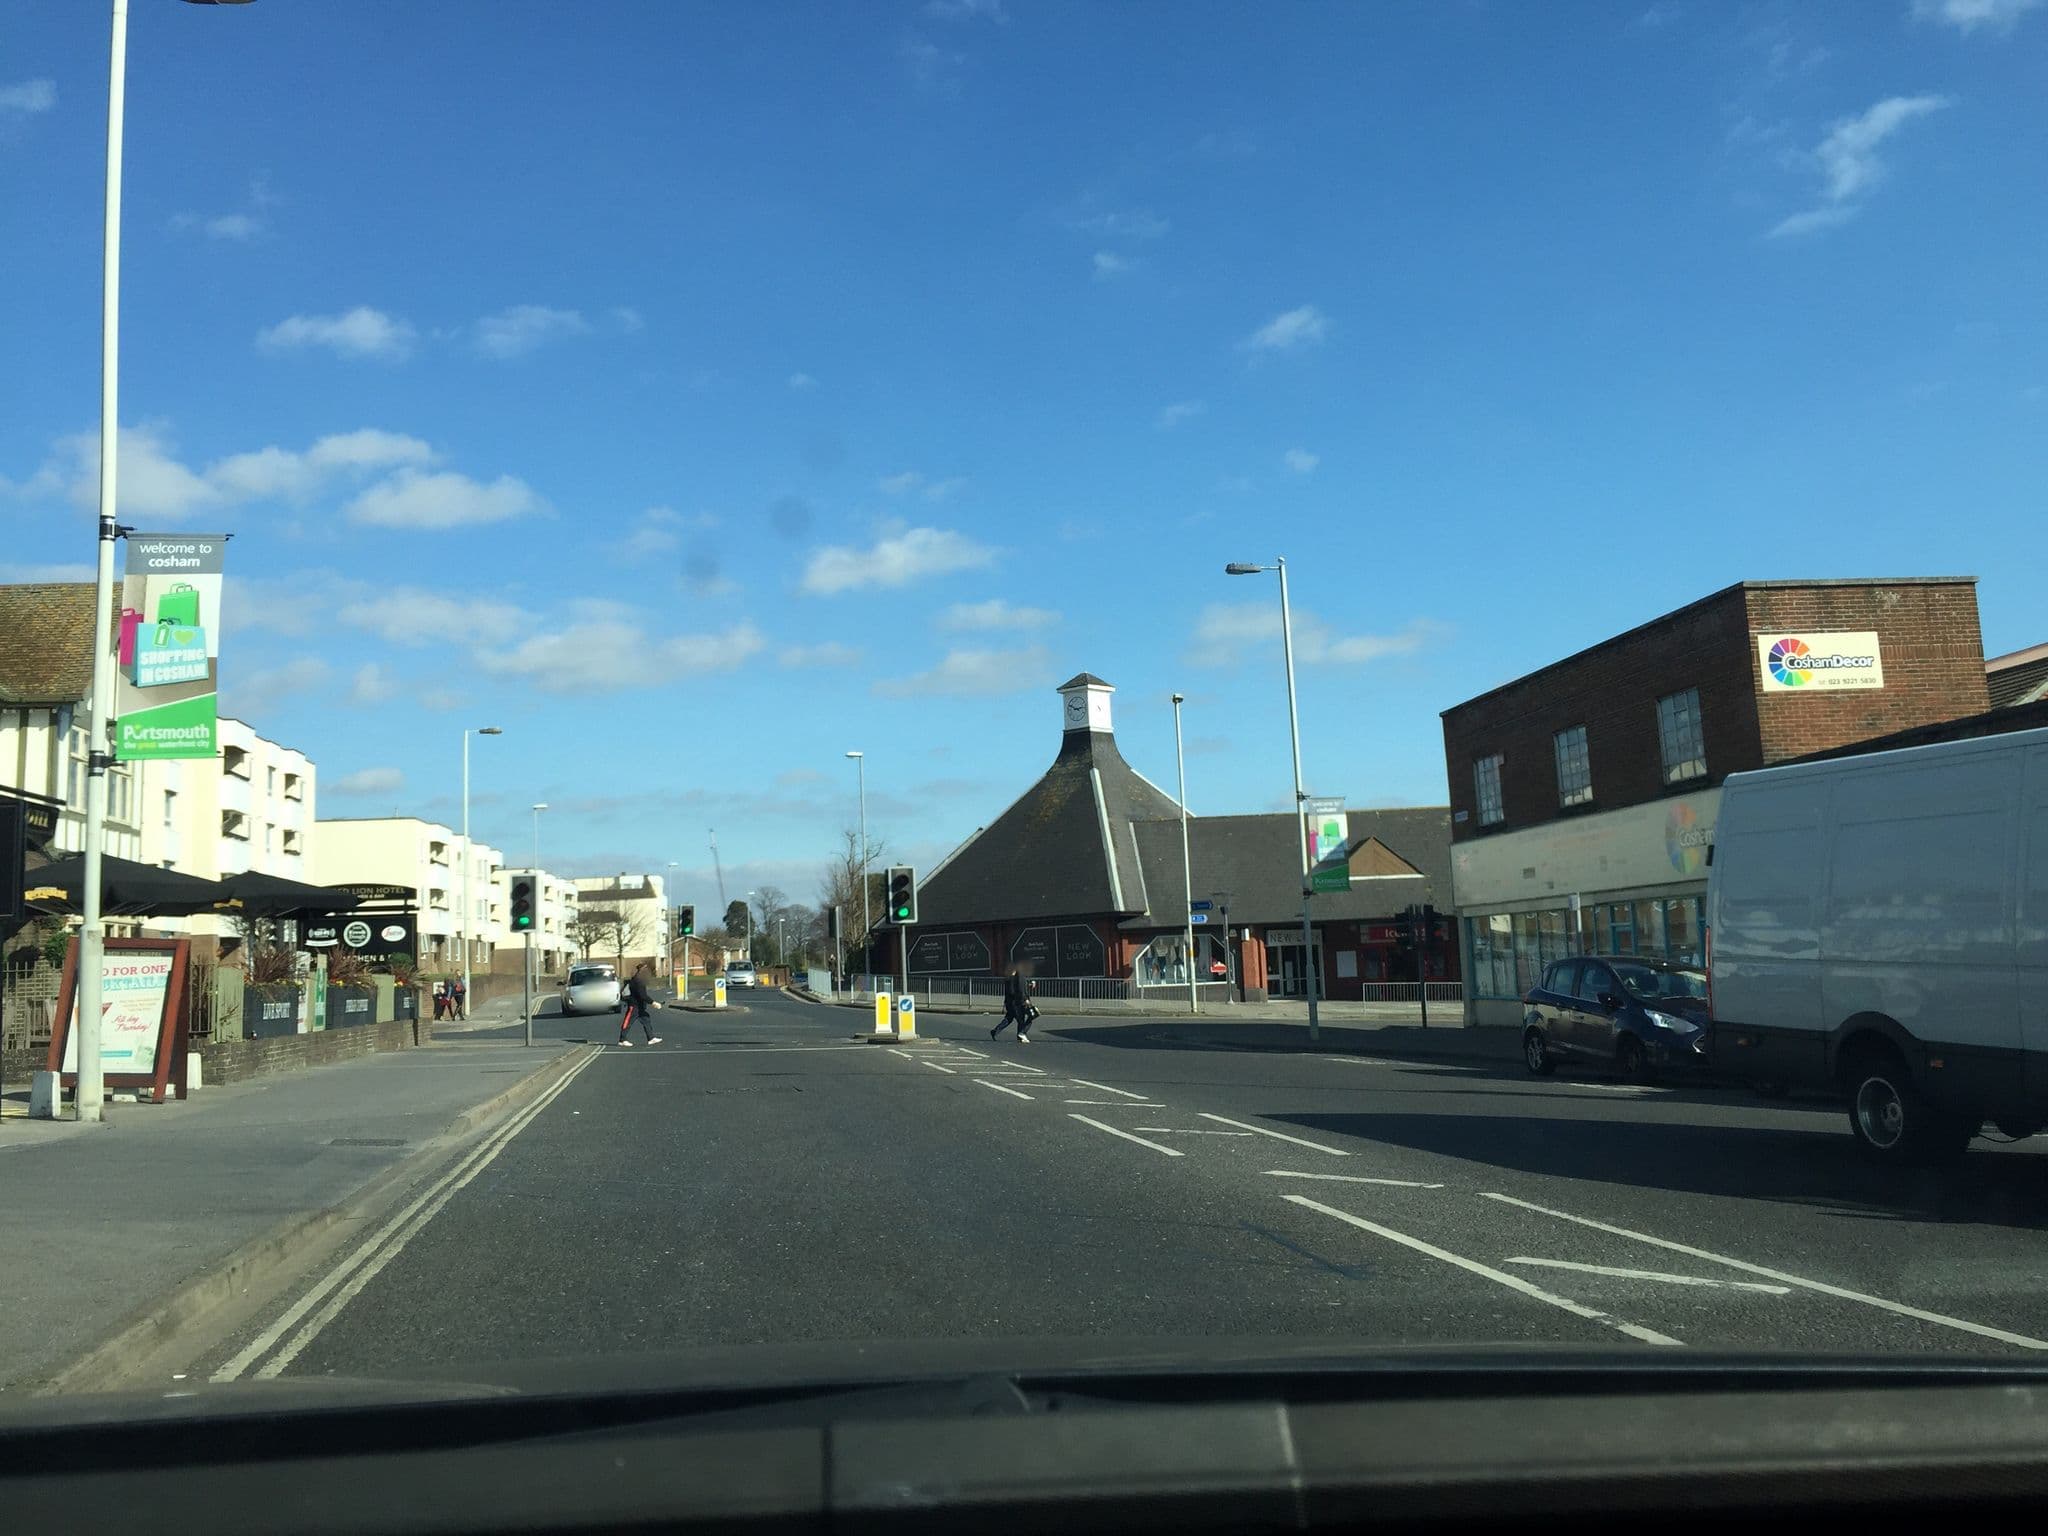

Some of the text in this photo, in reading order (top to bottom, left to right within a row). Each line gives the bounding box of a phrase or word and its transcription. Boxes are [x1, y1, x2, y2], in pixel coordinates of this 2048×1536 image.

[139, 543, 213, 554] welcome to
[148, 555, 201, 567] cosham
[140, 648, 206, 666] SHOPPING
[1785, 655, 1875, 669] CoshamDecor
[141, 663, 208, 683] IN COSHAM
[123, 724, 210, 740] Portsmouth
[124, 741, 137, 749] the
[198, 740, 210, 749] city
[112, 967, 137, 976] FOR
[141, 966, 167, 974] ONE
